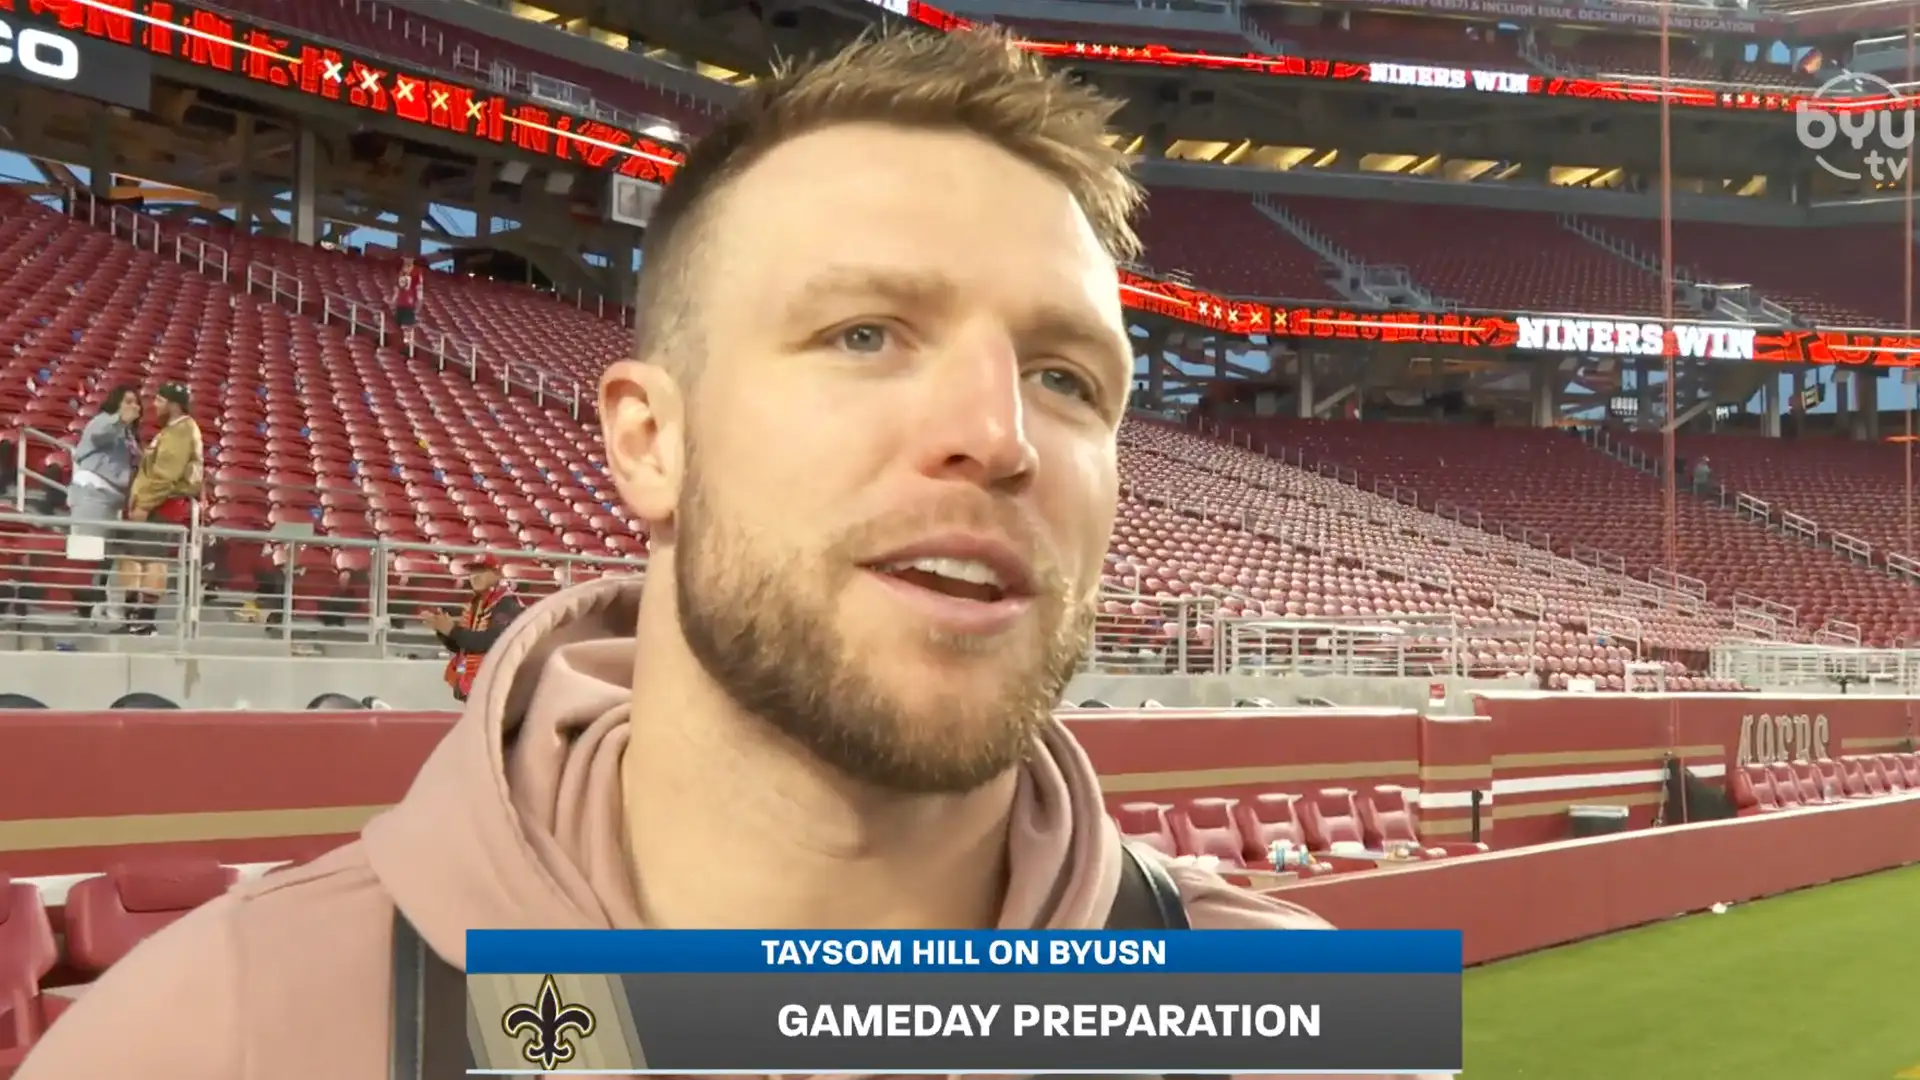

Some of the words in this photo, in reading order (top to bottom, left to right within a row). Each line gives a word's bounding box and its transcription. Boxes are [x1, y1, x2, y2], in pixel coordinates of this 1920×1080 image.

[1482, 2, 1536, 16] INCLUDE
[0, 20, 79, 80] O
[1369, 62, 1466, 89] NINERS
[1472, 70, 1529, 93] WIN
[1516, 316, 1664, 355] NINERS
[1672, 325, 1756, 360] WIN
